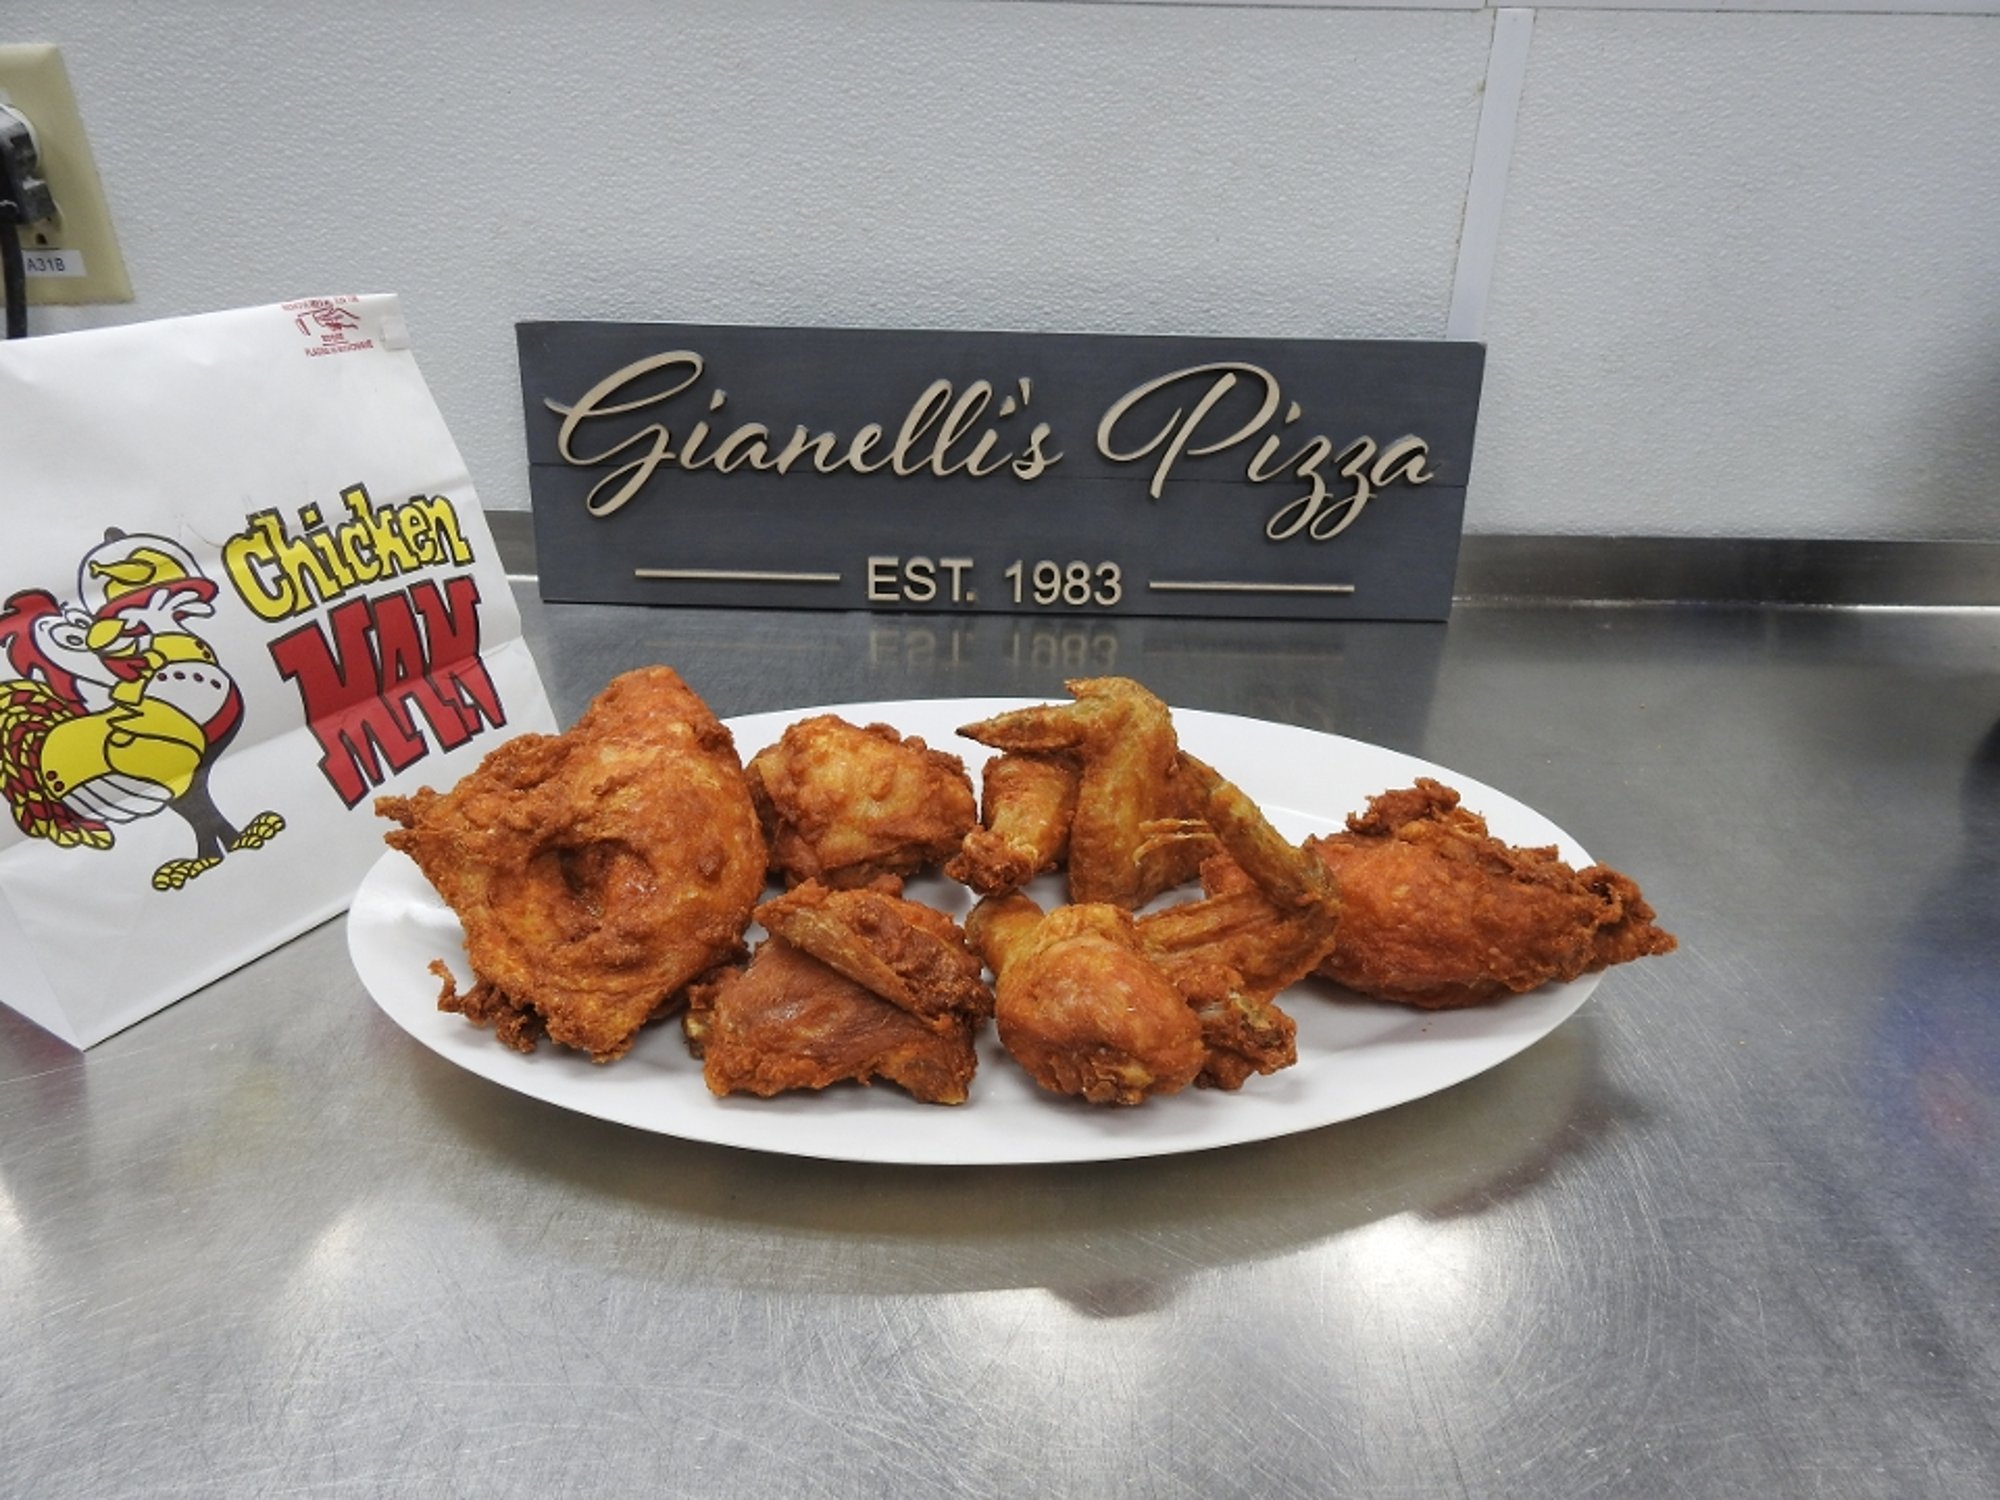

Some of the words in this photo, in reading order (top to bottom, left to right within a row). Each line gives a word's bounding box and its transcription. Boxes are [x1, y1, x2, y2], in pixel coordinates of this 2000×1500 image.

[27, 257, 66, 272] A31B
[544, 350, 1063, 518] Gianelli's
[1097, 361, 1437, 541] Pizza
[221, 477, 475, 623] Chicken
[867, 556, 976, 603] EST.
[1004, 559, 1123, 606] 1983
[267, 573, 507, 811] MAN
